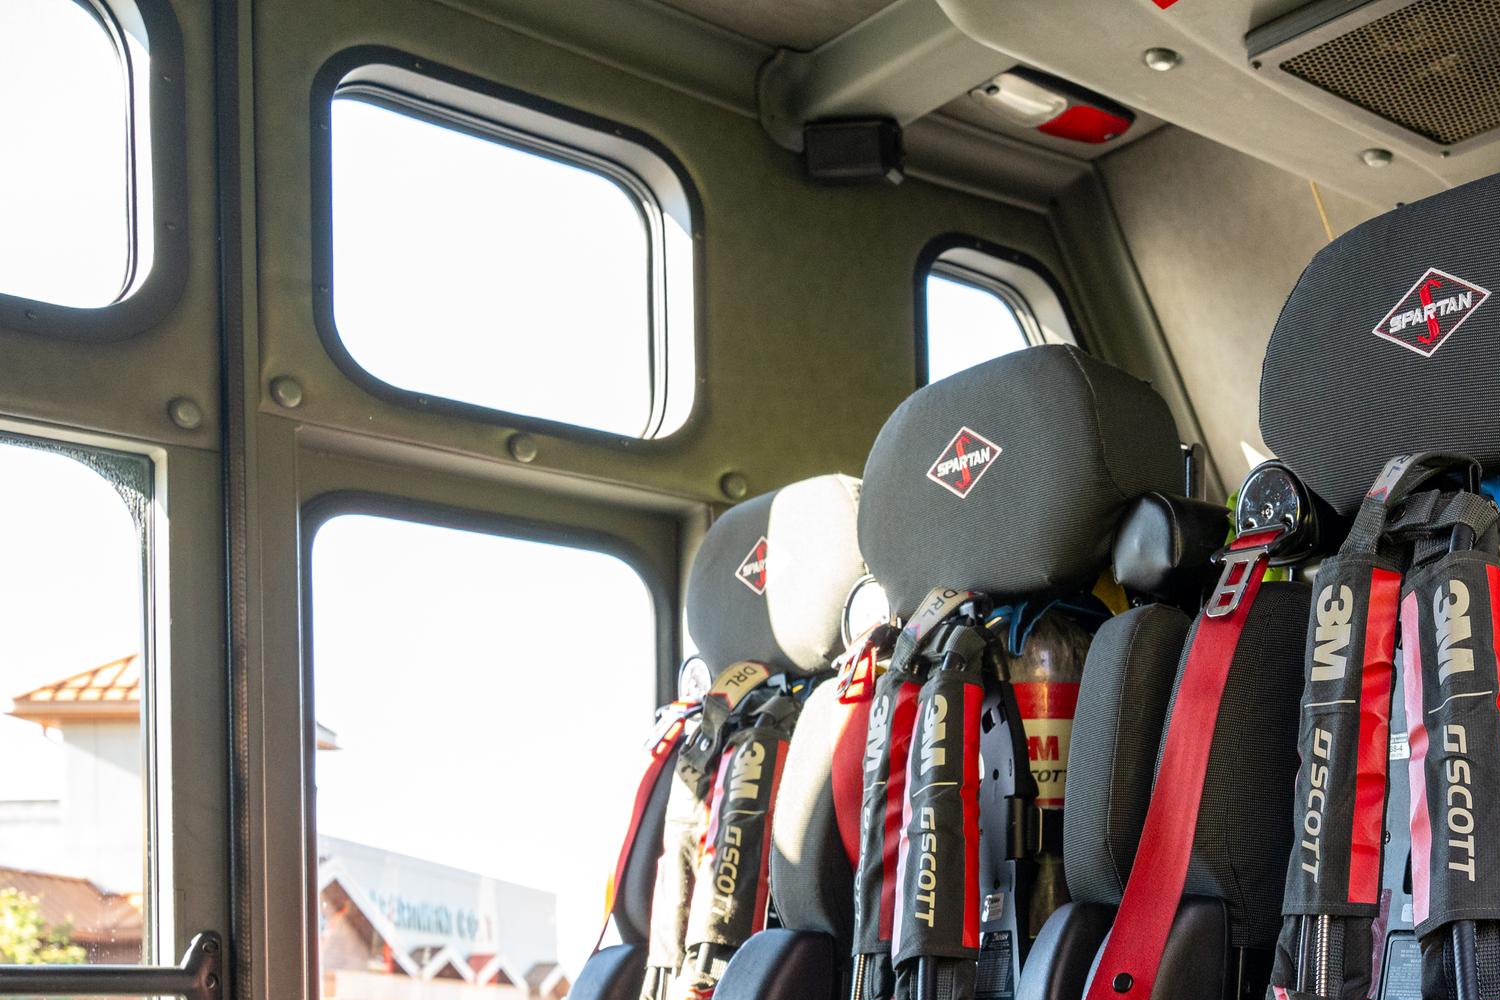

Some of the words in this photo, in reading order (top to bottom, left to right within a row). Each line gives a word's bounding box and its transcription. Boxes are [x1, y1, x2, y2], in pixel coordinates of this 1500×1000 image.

[1389, 291, 1472, 333] SPARTAN
[937, 446, 990, 477] SPARTAN
[1310, 584, 1353, 681] 3M
[1433, 579, 1475, 686] 3M
[725, 665, 757, 686] DRL
[729, 742, 765, 801] 3M
[866, 696, 889, 772] 3M
[920, 695, 948, 776] 3M
[1301, 762, 1329, 883] SCOTT
[1446, 759, 1475, 881] SCOTT
[915, 833, 936, 928] SCOTT
